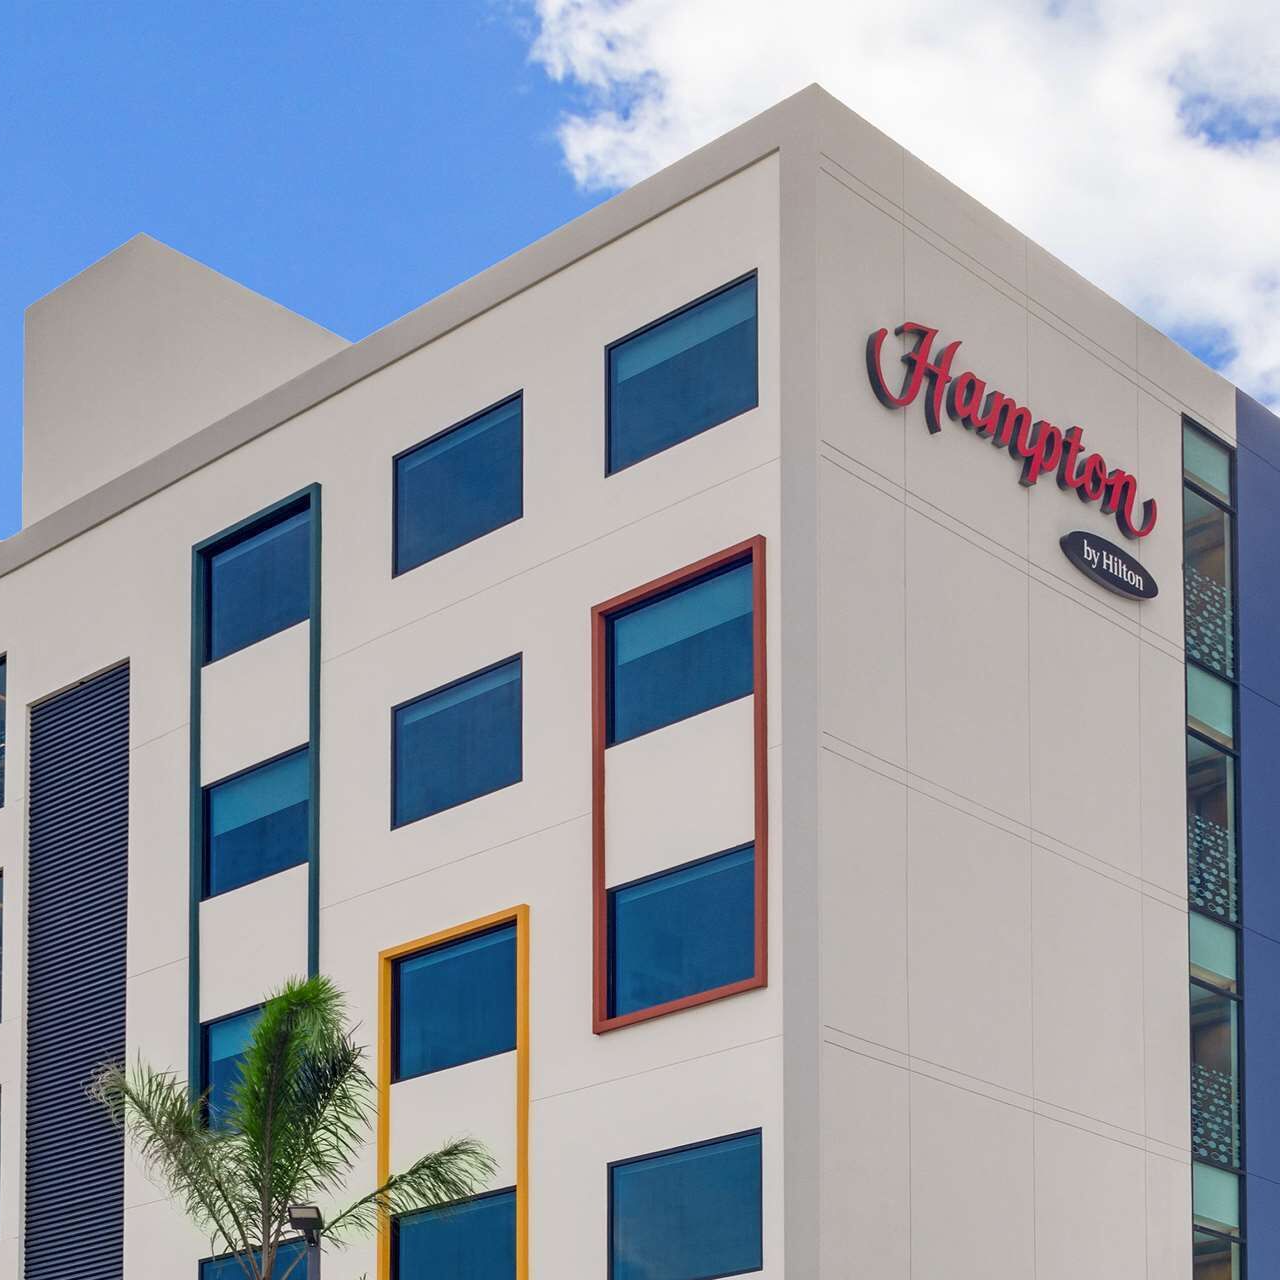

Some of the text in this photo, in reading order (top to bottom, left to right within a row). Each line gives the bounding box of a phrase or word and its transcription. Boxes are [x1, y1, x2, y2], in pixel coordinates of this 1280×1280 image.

[866, 321, 1157, 539] Hampton
[1083, 539, 1144, 591] by Hilton
